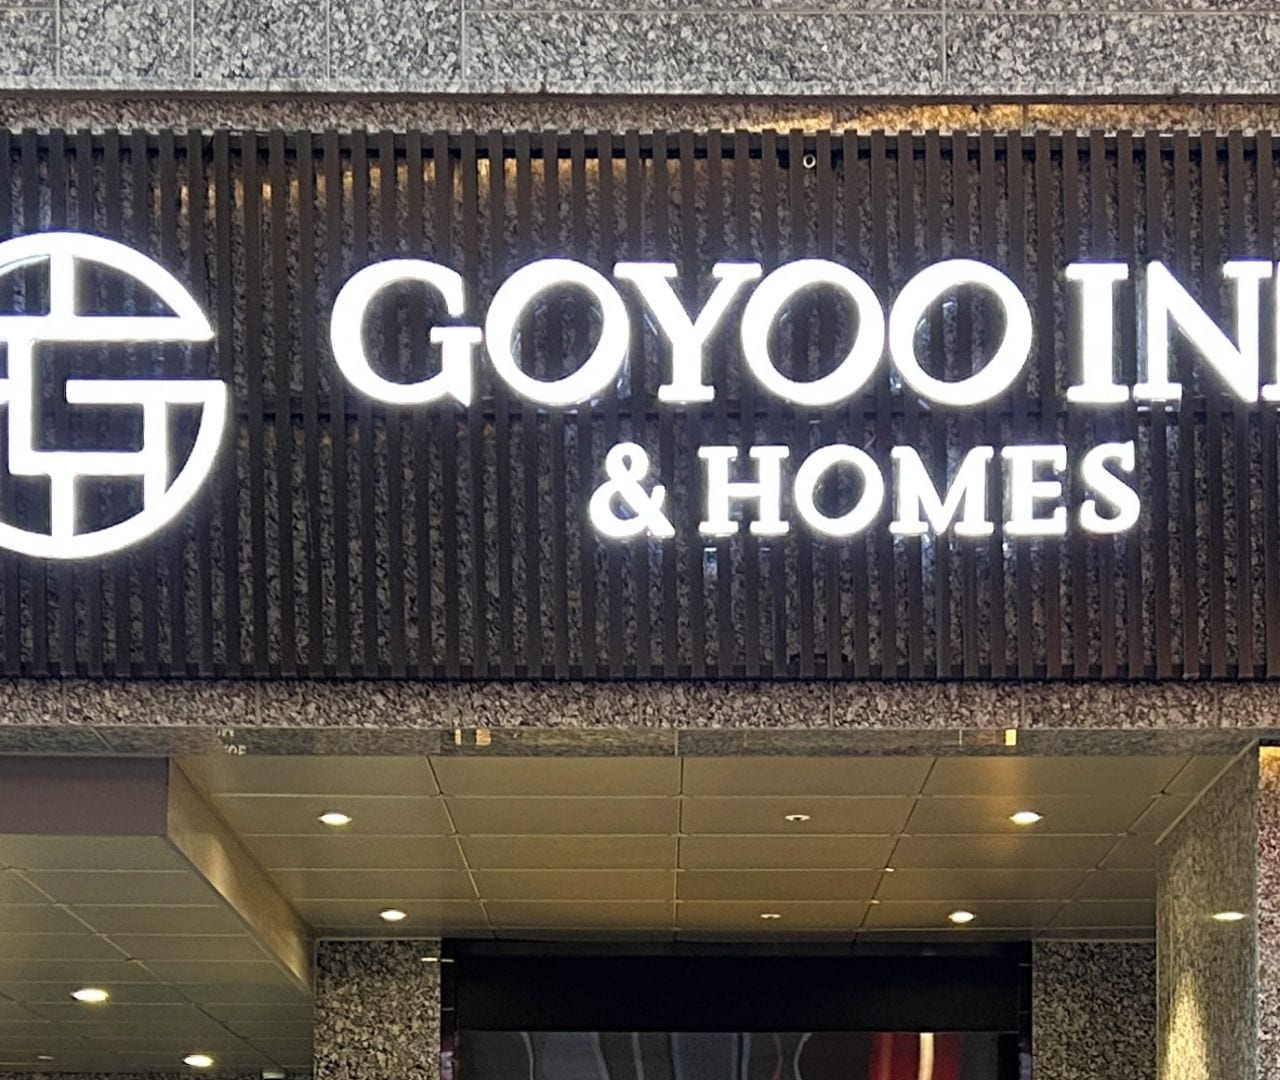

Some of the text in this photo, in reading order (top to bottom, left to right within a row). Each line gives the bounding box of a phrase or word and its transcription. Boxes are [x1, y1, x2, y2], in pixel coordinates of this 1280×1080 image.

[330, 258, 1034, 408] GOYOO
[588, 442, 1141, 541] & HOMES
